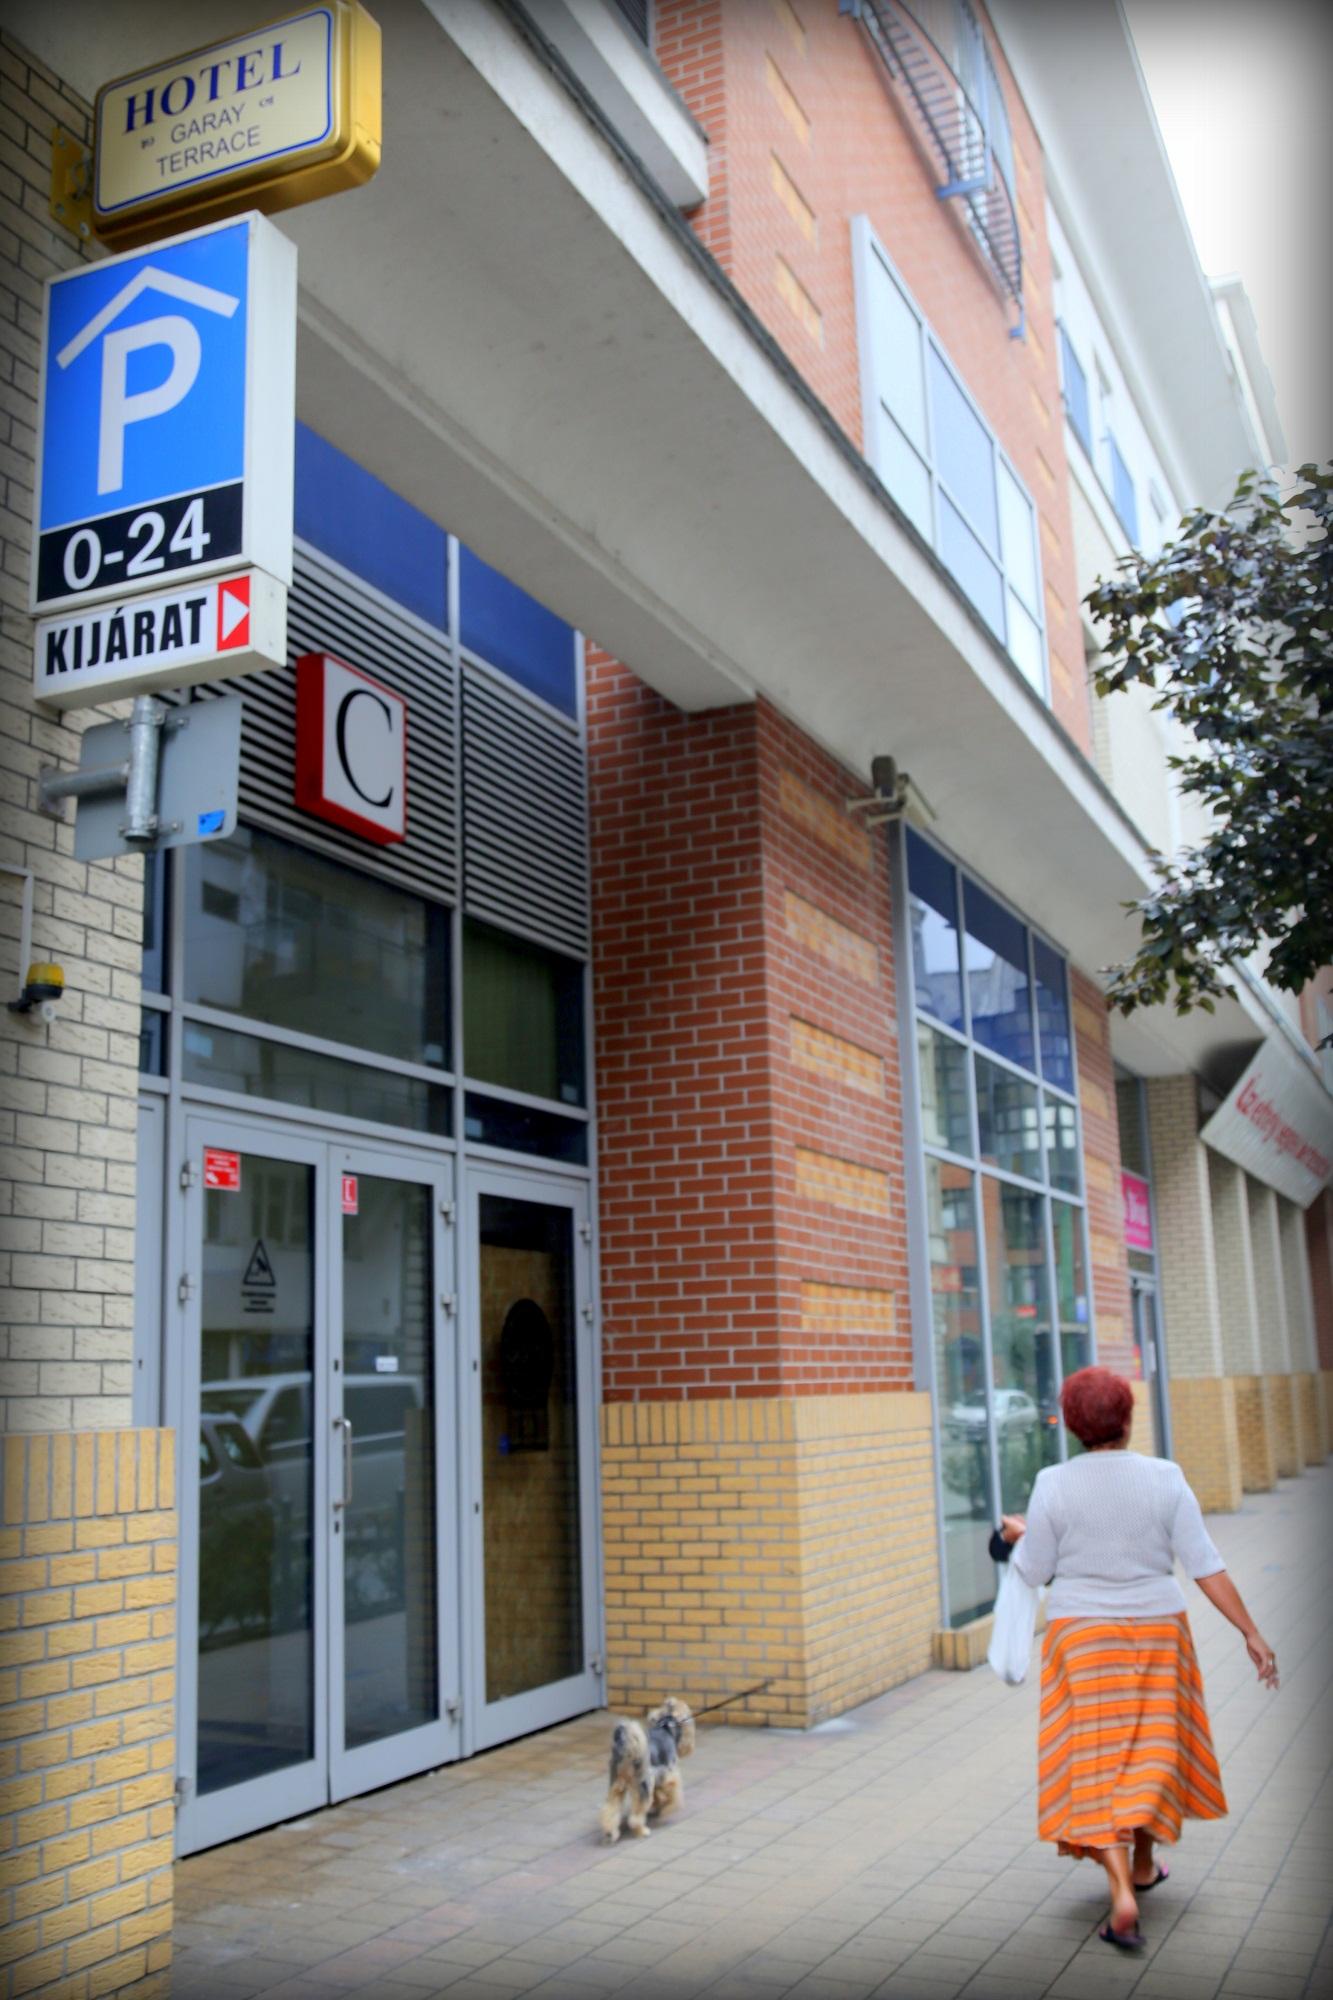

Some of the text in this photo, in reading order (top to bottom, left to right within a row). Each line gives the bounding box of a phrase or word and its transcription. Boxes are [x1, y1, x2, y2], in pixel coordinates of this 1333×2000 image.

[121, 40, 302, 136] HOTEL
[169, 102, 246, 145] GARAY
[156, 124, 262, 177] TERRACE
[97, 314, 202, 495] P
[63, 498, 211, 590] 0-24
[46, 597, 207, 676] KIJÁRAT
[335, 688, 394, 808] C
